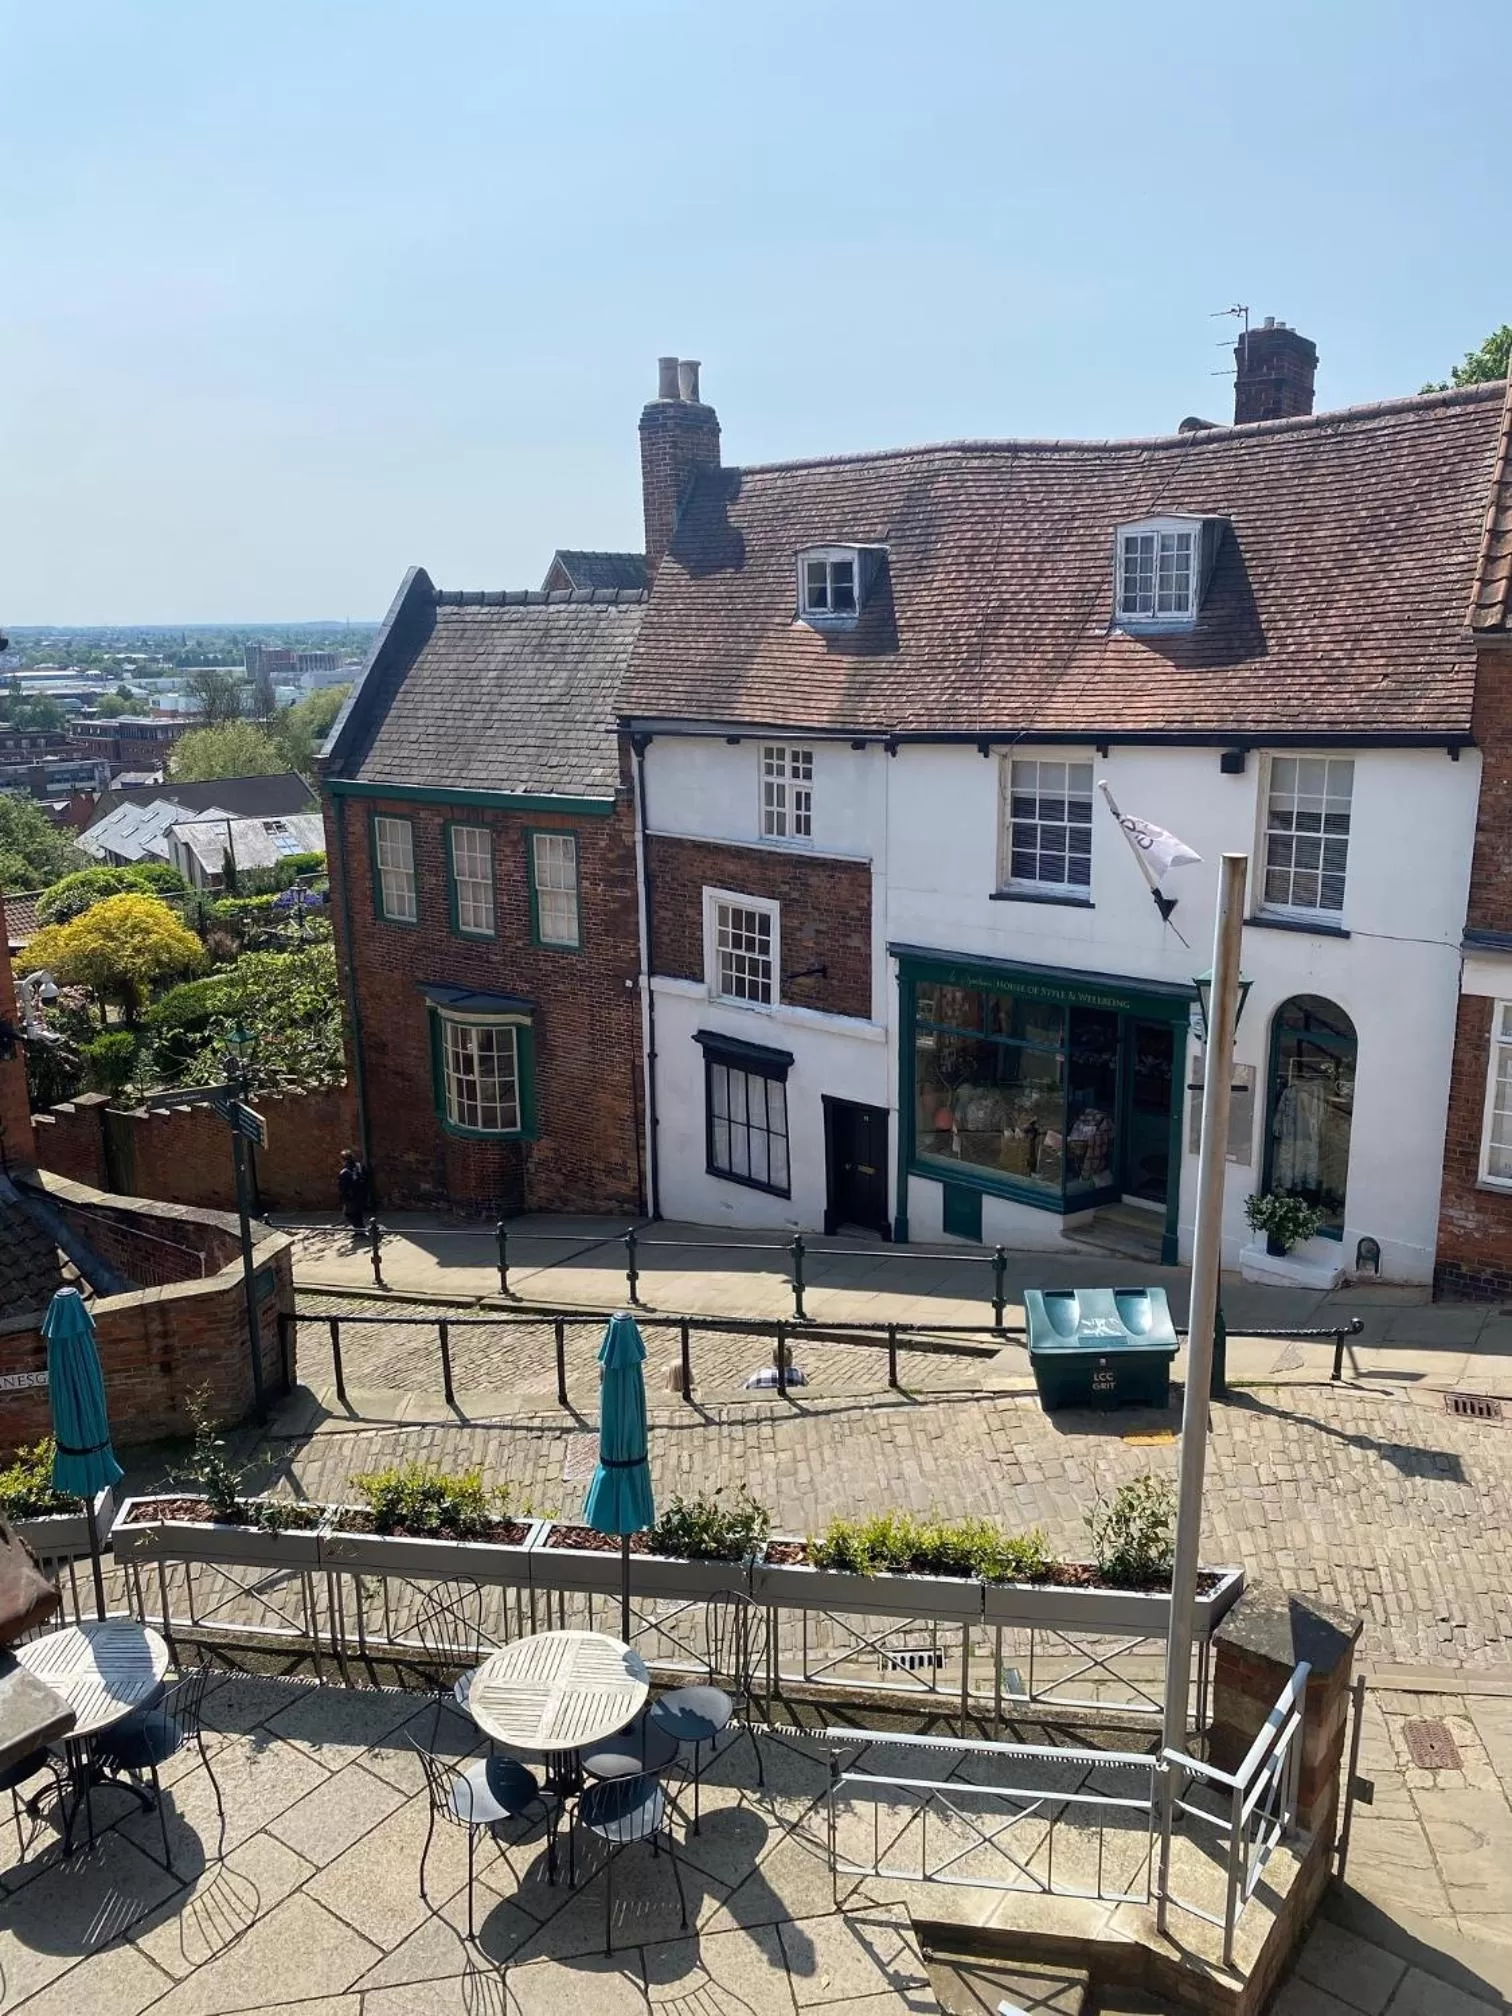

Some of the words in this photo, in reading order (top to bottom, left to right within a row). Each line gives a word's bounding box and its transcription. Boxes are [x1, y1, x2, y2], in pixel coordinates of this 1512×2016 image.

[1068, 990, 1077, 1001] &
[0, 1373, 47, 1389] NESG
[1093, 1372, 1114, 1381] LCC
[1092, 1382, 1116, 1390] GRIT
